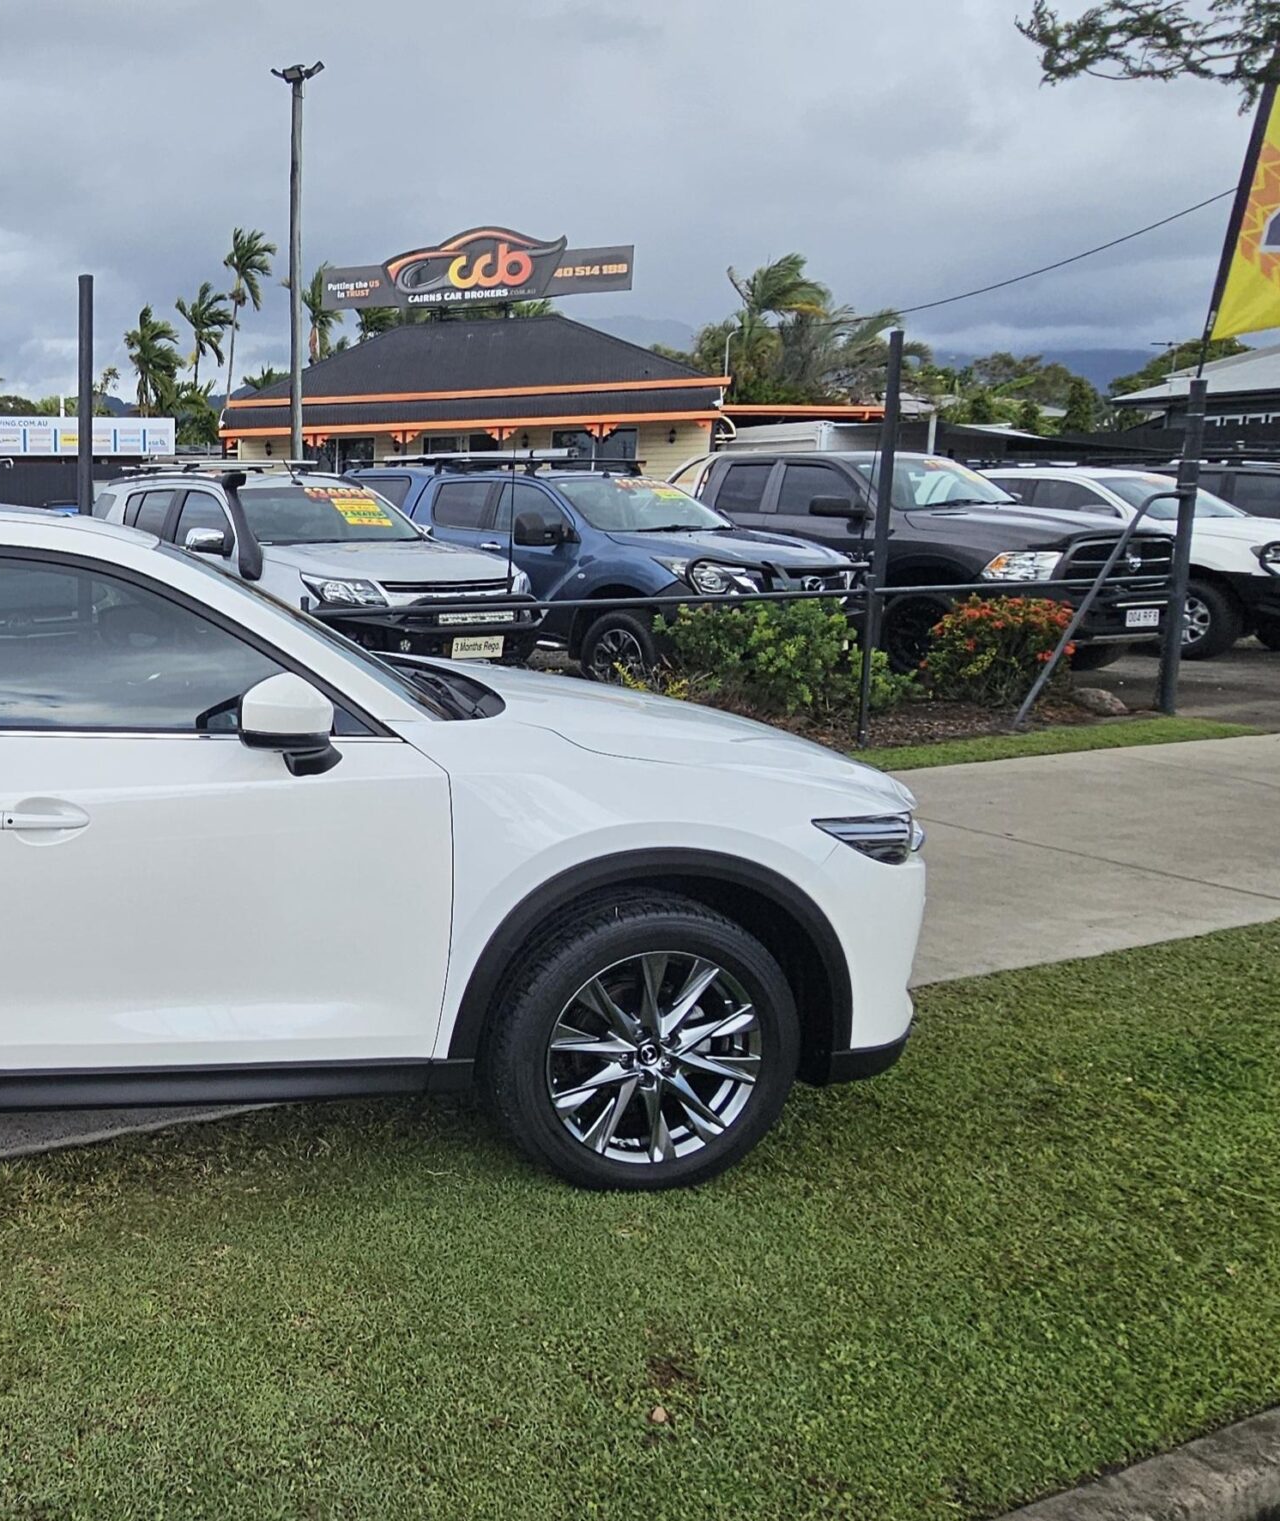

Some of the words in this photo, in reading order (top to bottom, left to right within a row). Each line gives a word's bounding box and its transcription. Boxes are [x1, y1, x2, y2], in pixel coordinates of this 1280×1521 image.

[553, 267, 573, 278] 40
[575, 265, 600, 276] 514
[328, 281, 355, 291] Putting
[346, 289, 370, 298] TRUST
[408, 293, 442, 303] CAIRNS
[444, 291, 462, 301] CAR
[454, 642, 460, 652] 3
[460, 641, 483, 651] Months
